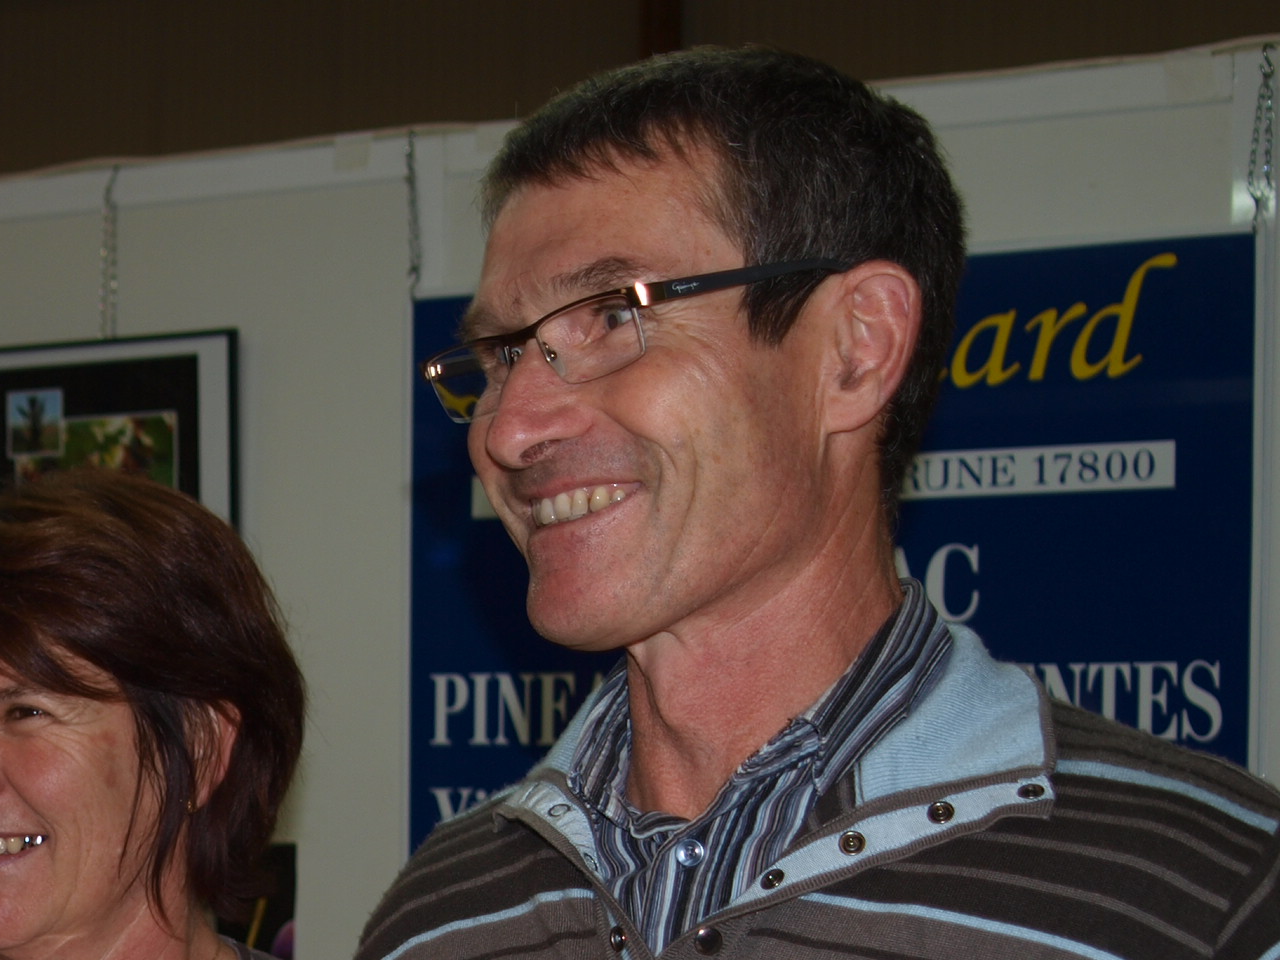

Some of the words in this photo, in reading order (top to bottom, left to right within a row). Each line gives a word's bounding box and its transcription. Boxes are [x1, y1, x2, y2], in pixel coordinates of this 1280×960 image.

[939, 252, 1177, 389] ard
[1032, 448, 1157, 488] 17800
[429, 672, 604, 746] PINE
[1030, 659, 1223, 742] NTES
